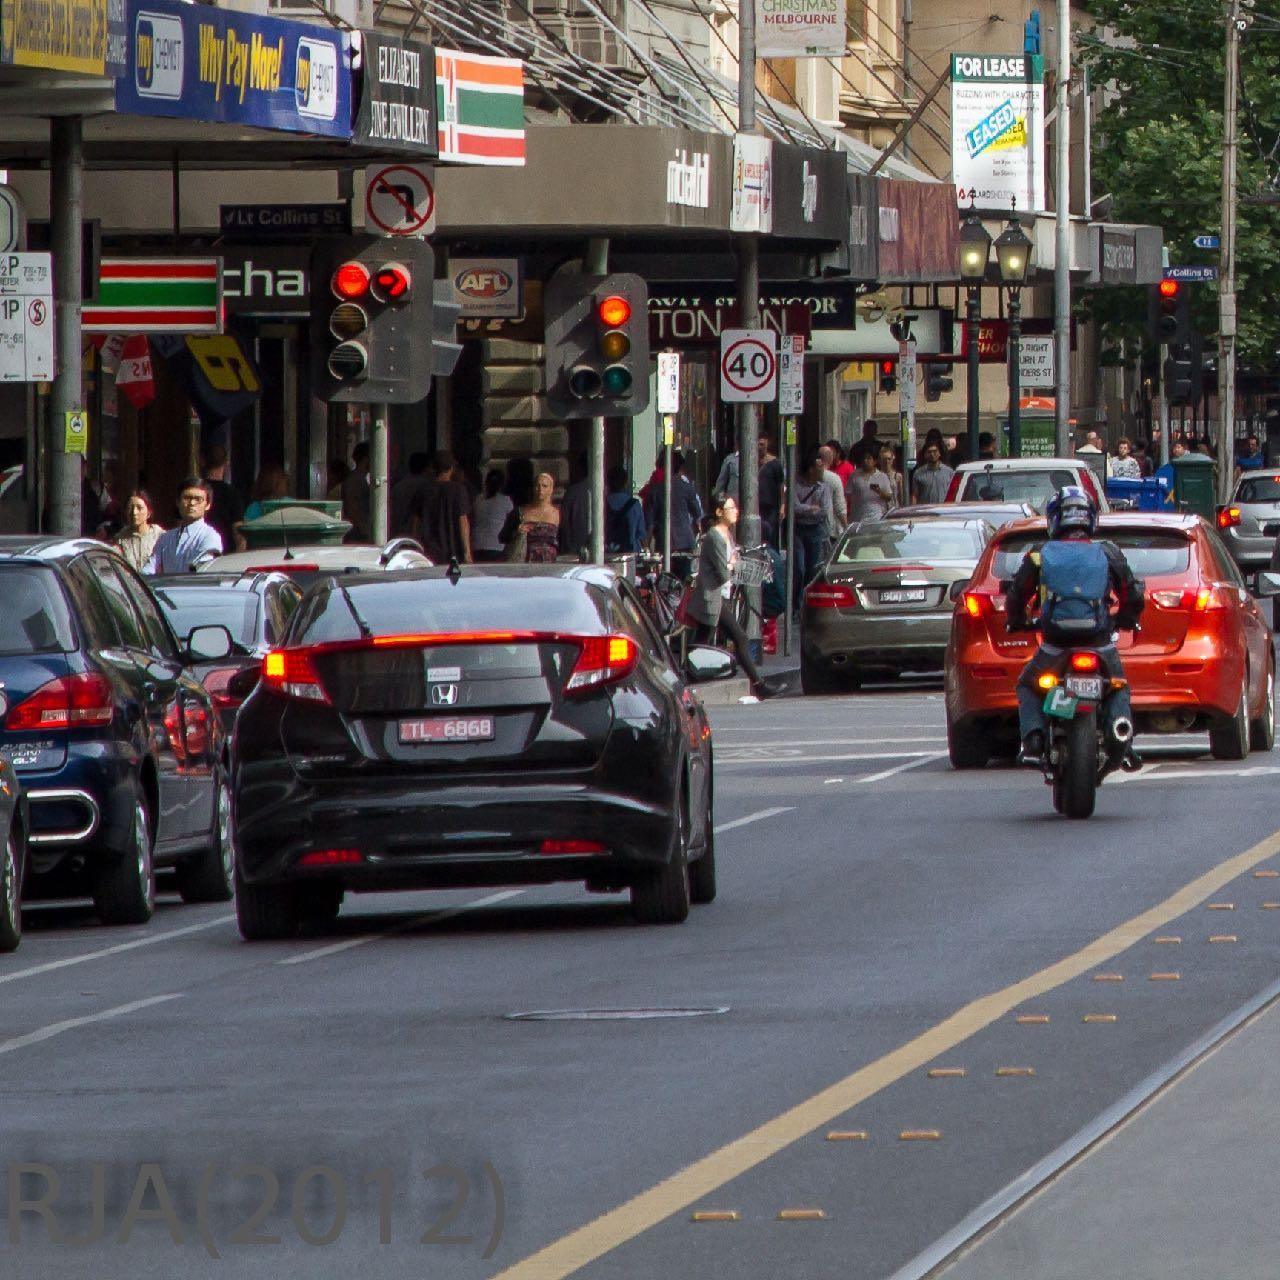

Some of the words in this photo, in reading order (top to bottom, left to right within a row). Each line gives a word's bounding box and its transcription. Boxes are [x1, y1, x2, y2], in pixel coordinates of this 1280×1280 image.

[764, 14, 837, 24] MELBOURNE
[199, 23, 225, 103] Why
[226, 28, 249, 105] Pay
[250, 32, 284, 92] More!
[378, 46, 420, 89] ELIZABETH
[955, 56, 982, 77] FOR
[983, 57, 1026, 78] LEASE
[967, 104, 1015, 154] LEASED
[258, 208, 318, 225] Collins
[460, 272, 509, 291] AFL
[1025, 343, 1048, 352] RIGHT
[728, 352, 768, 379] 40
[1042, 368, 1052, 376] ST
